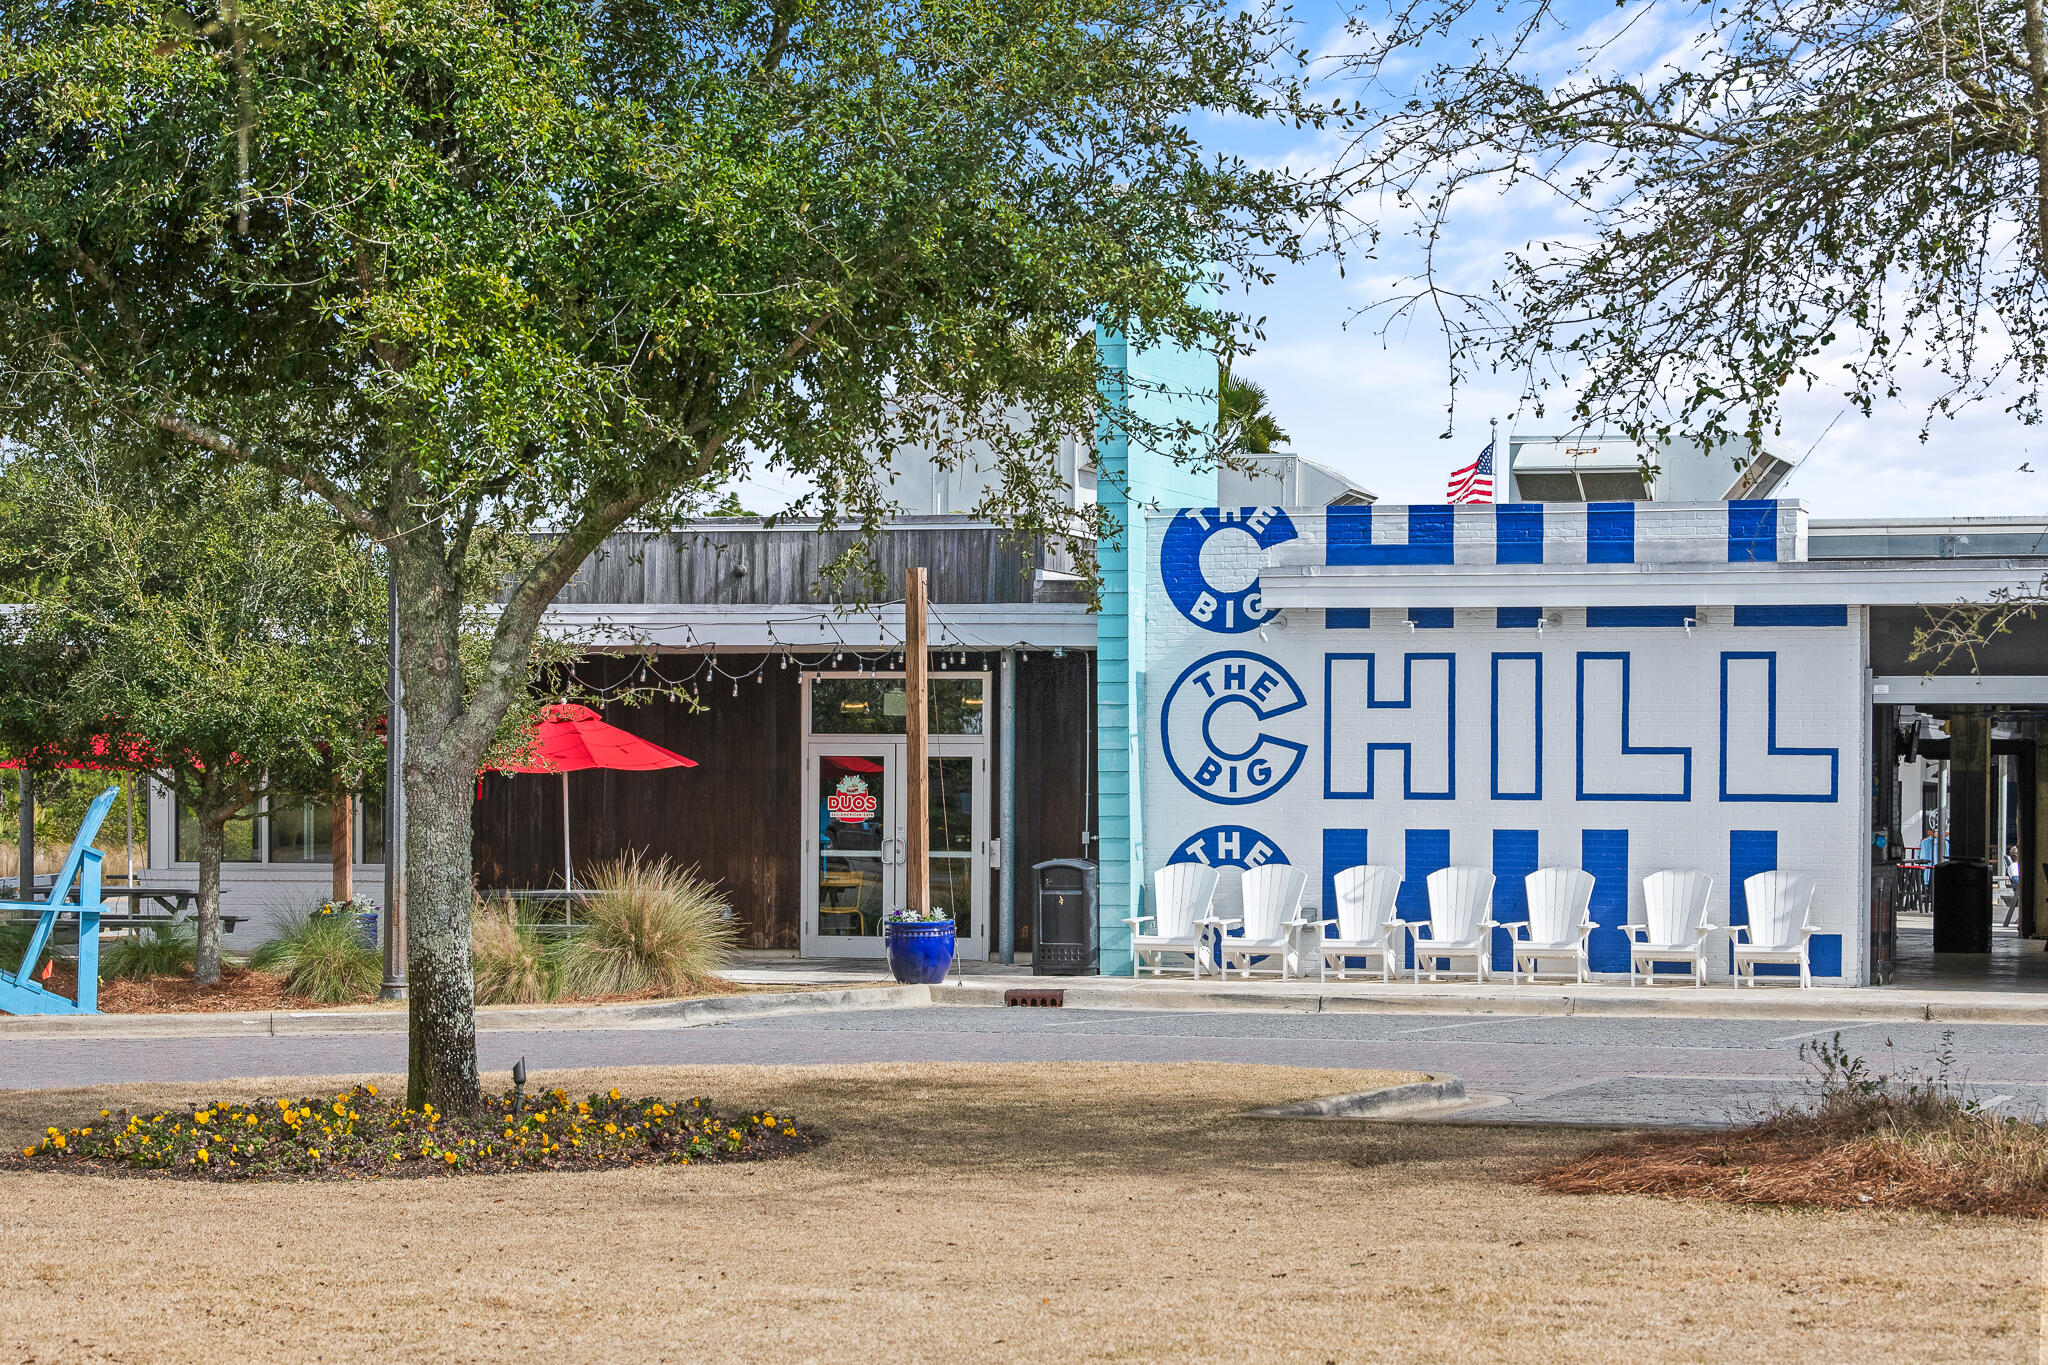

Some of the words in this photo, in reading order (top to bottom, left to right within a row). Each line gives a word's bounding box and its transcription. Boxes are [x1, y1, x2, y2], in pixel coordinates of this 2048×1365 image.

[1185, 506, 1279, 535] THE
[1189, 590, 1269, 628] BIG
[1192, 664, 1279, 703] THE
[1160, 650, 1841, 806] CHILL
[1193, 756, 1272, 793] BIG
[828, 795, 877, 811] DUOS
[1185, 831, 1274, 868] THE
